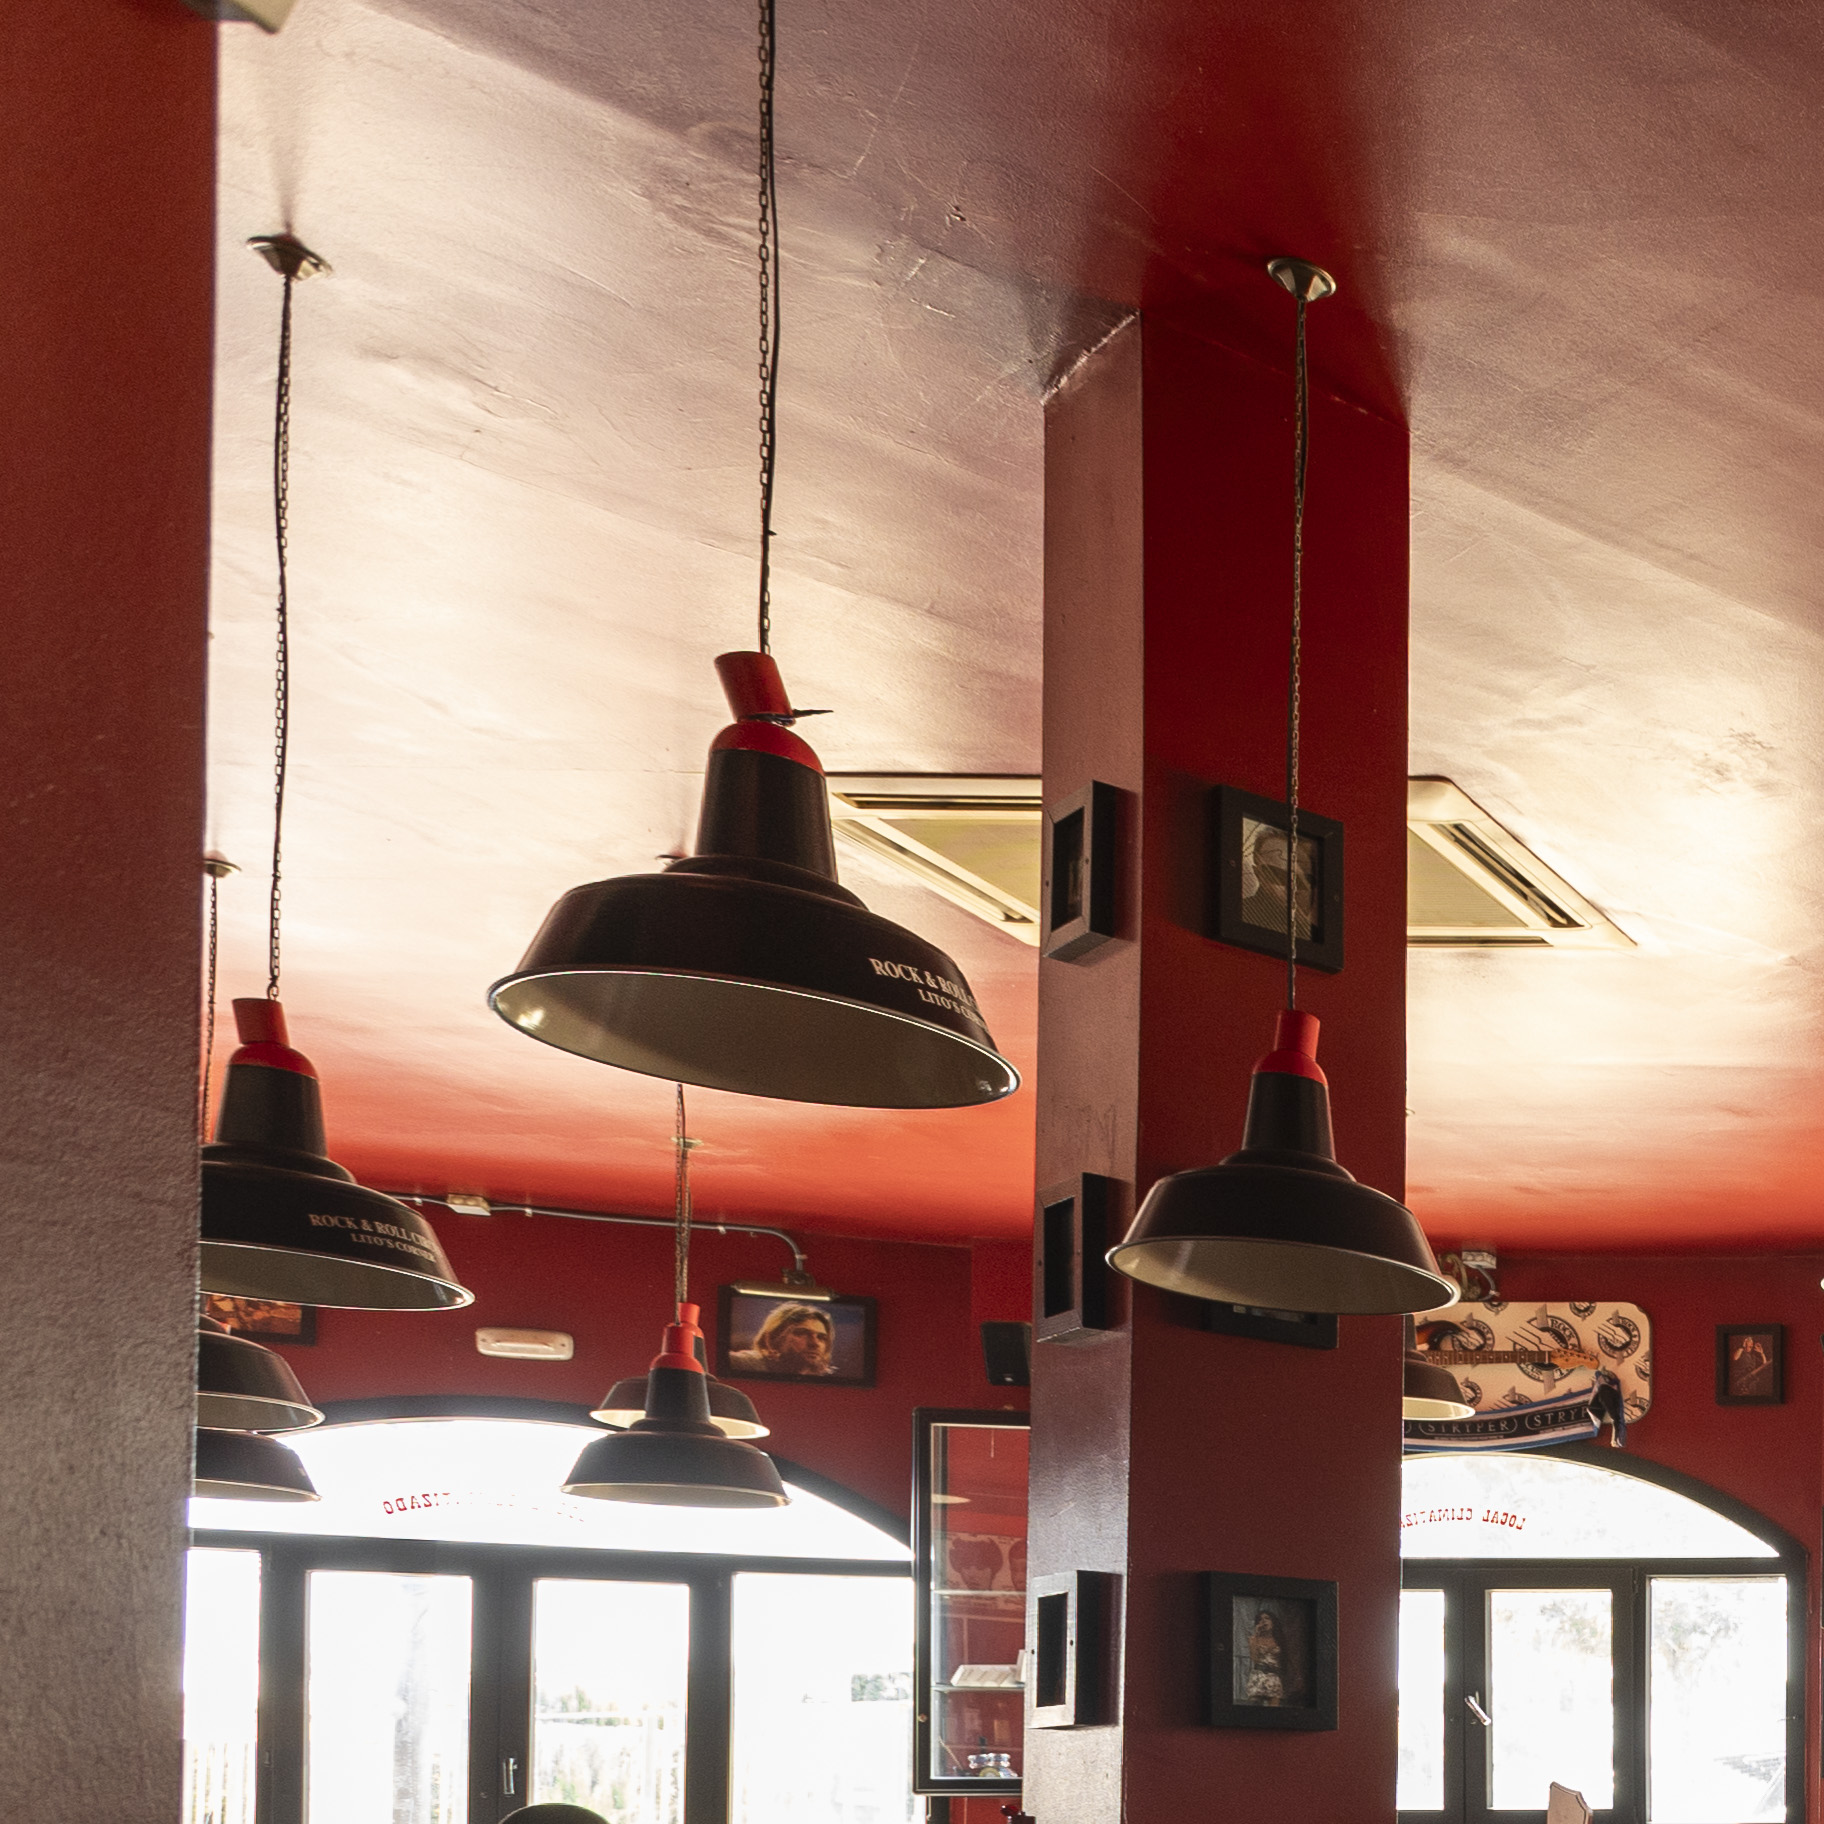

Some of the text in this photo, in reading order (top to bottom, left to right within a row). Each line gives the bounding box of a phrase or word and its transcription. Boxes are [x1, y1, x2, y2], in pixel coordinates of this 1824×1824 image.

[868, 958, 925, 985] ROCK
[922, 970, 940, 989] &
[917, 988, 961, 1014] LITO'S
[308, 1213, 411, 1242] ROCK & ROLL
[351, 1233, 395, 1249] LITO'S
[1427, 1406, 1589, 1434] STRYPER STRYP
